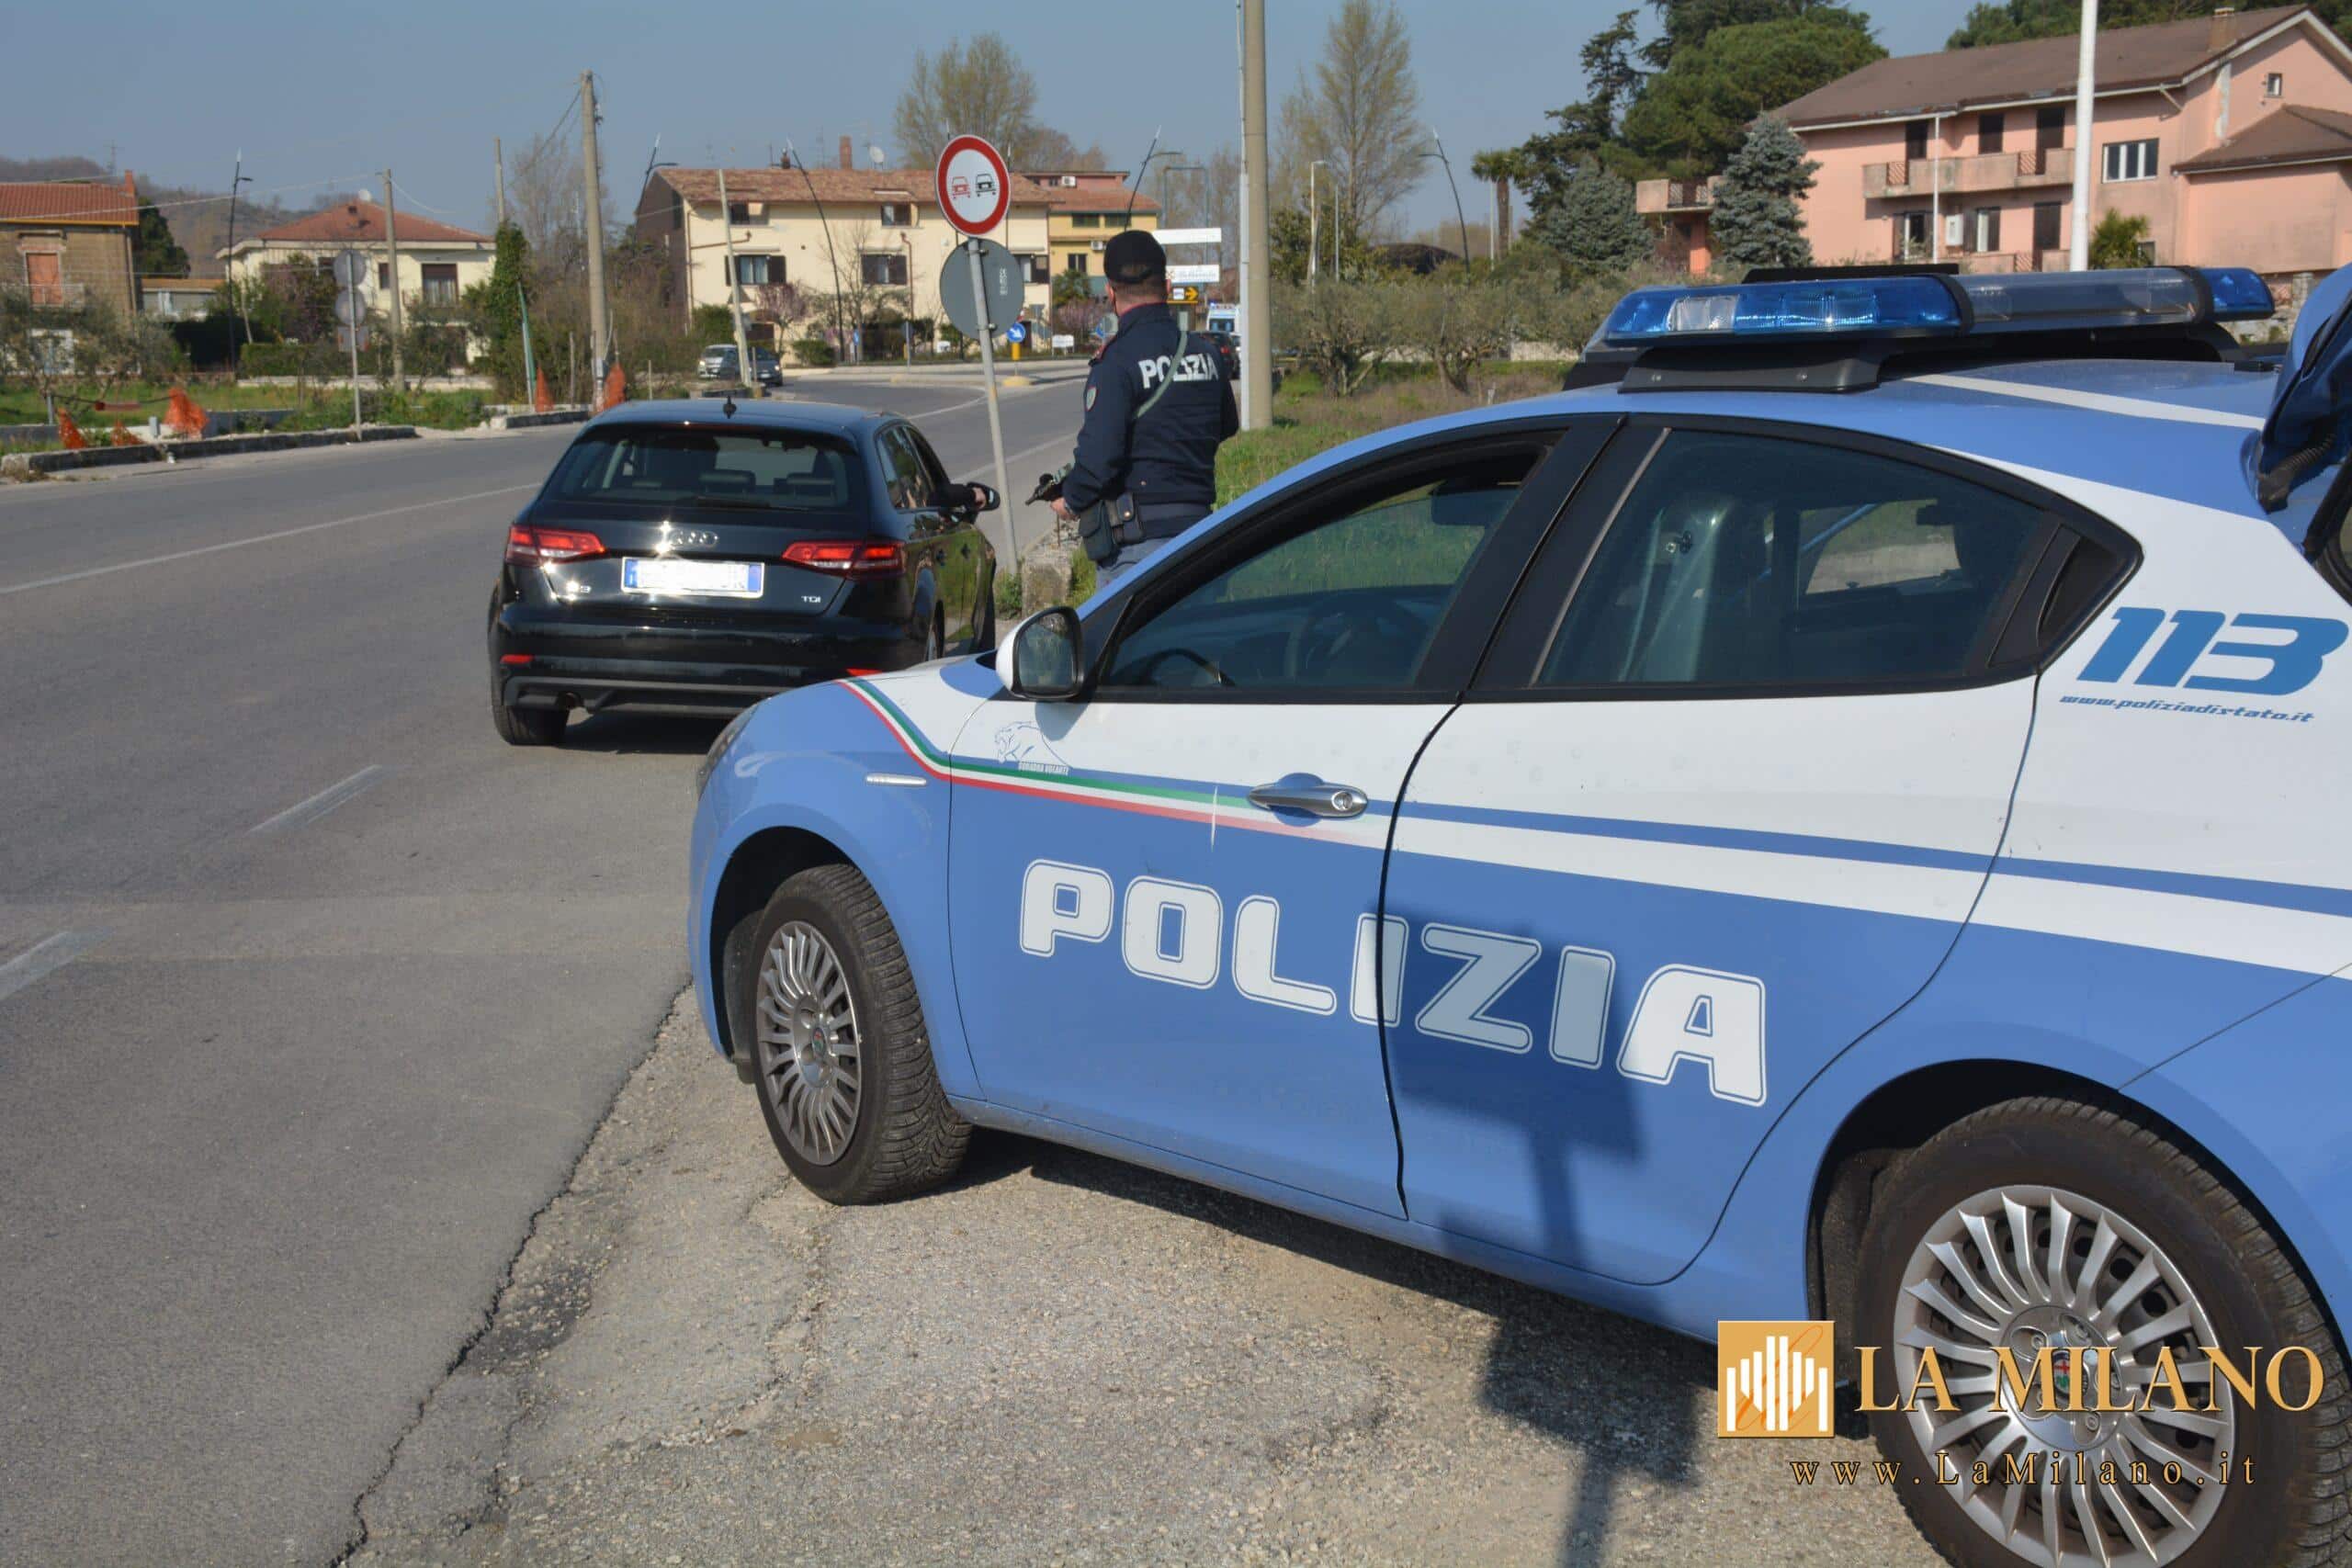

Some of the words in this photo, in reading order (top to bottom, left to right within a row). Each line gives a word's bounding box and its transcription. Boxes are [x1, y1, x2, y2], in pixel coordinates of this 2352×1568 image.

[800, 595, 821, 604] TDI
[2075, 606, 2349, 696] 113
[2059, 695, 2314, 723] www.poliziadistato.it
[1020, 859, 1767, 1106] POLIZIA
